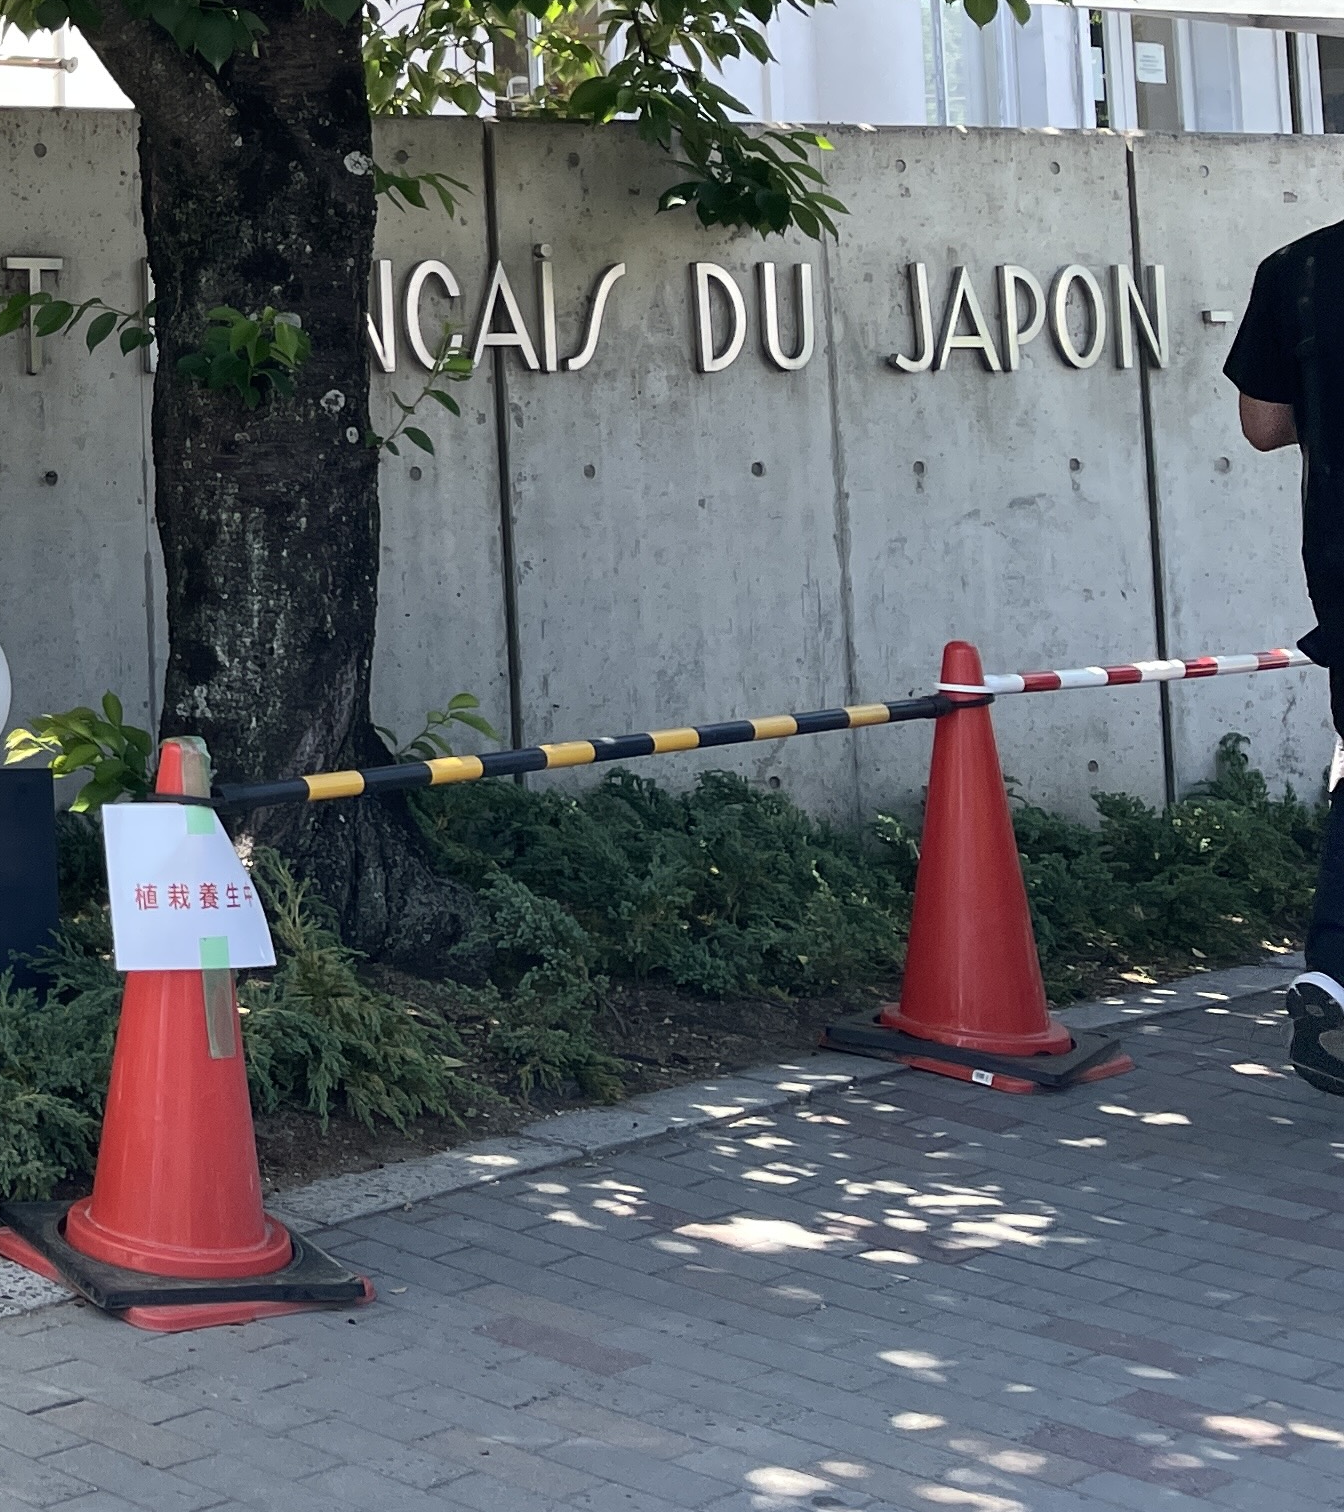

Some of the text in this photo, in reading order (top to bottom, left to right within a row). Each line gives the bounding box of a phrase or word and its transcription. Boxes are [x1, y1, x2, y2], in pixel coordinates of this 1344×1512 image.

[690, 261, 815, 373] DU
[888, 262, 1169, 373] JAPON
[134, 882, 254, 911] 植栽養生中
